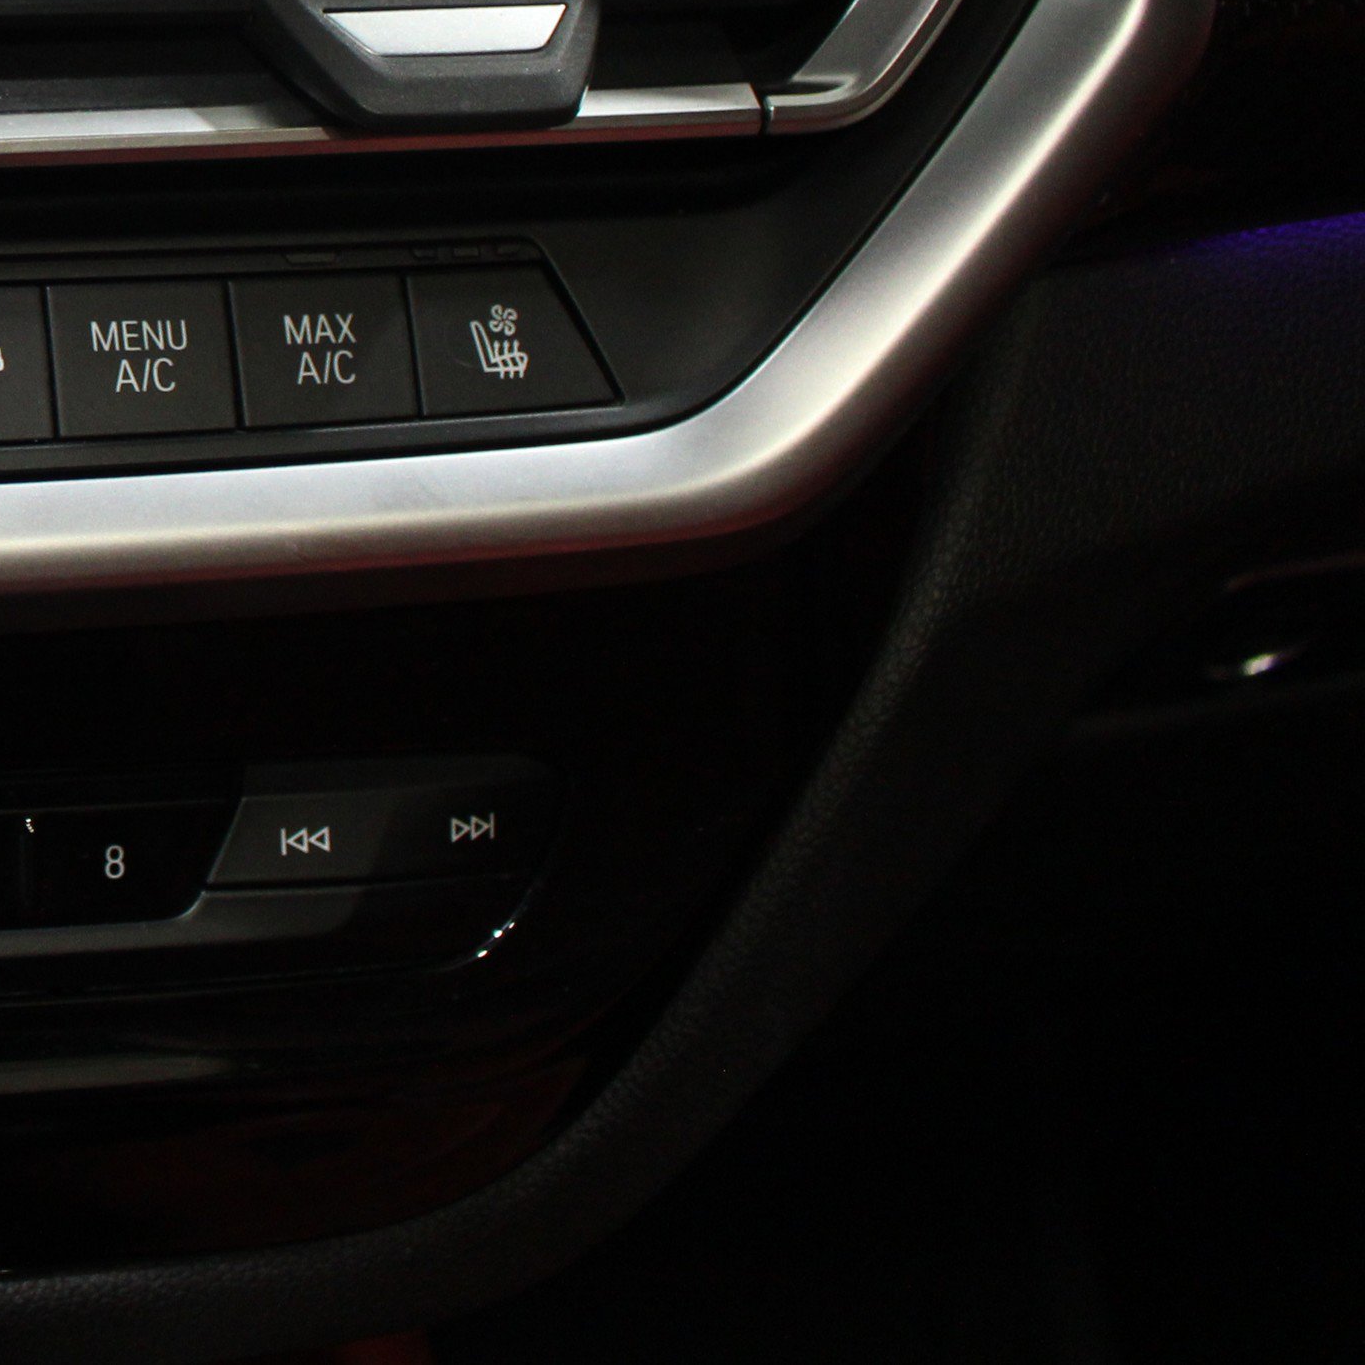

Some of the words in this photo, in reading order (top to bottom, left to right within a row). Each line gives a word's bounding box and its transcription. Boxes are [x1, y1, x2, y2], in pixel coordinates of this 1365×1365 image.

[90, 319, 188, 352] MENU
[283, 313, 356, 345] MAX
[115, 357, 176, 393] A/C
[297, 349, 356, 385] A/C
[104, 844, 125, 880] 8
